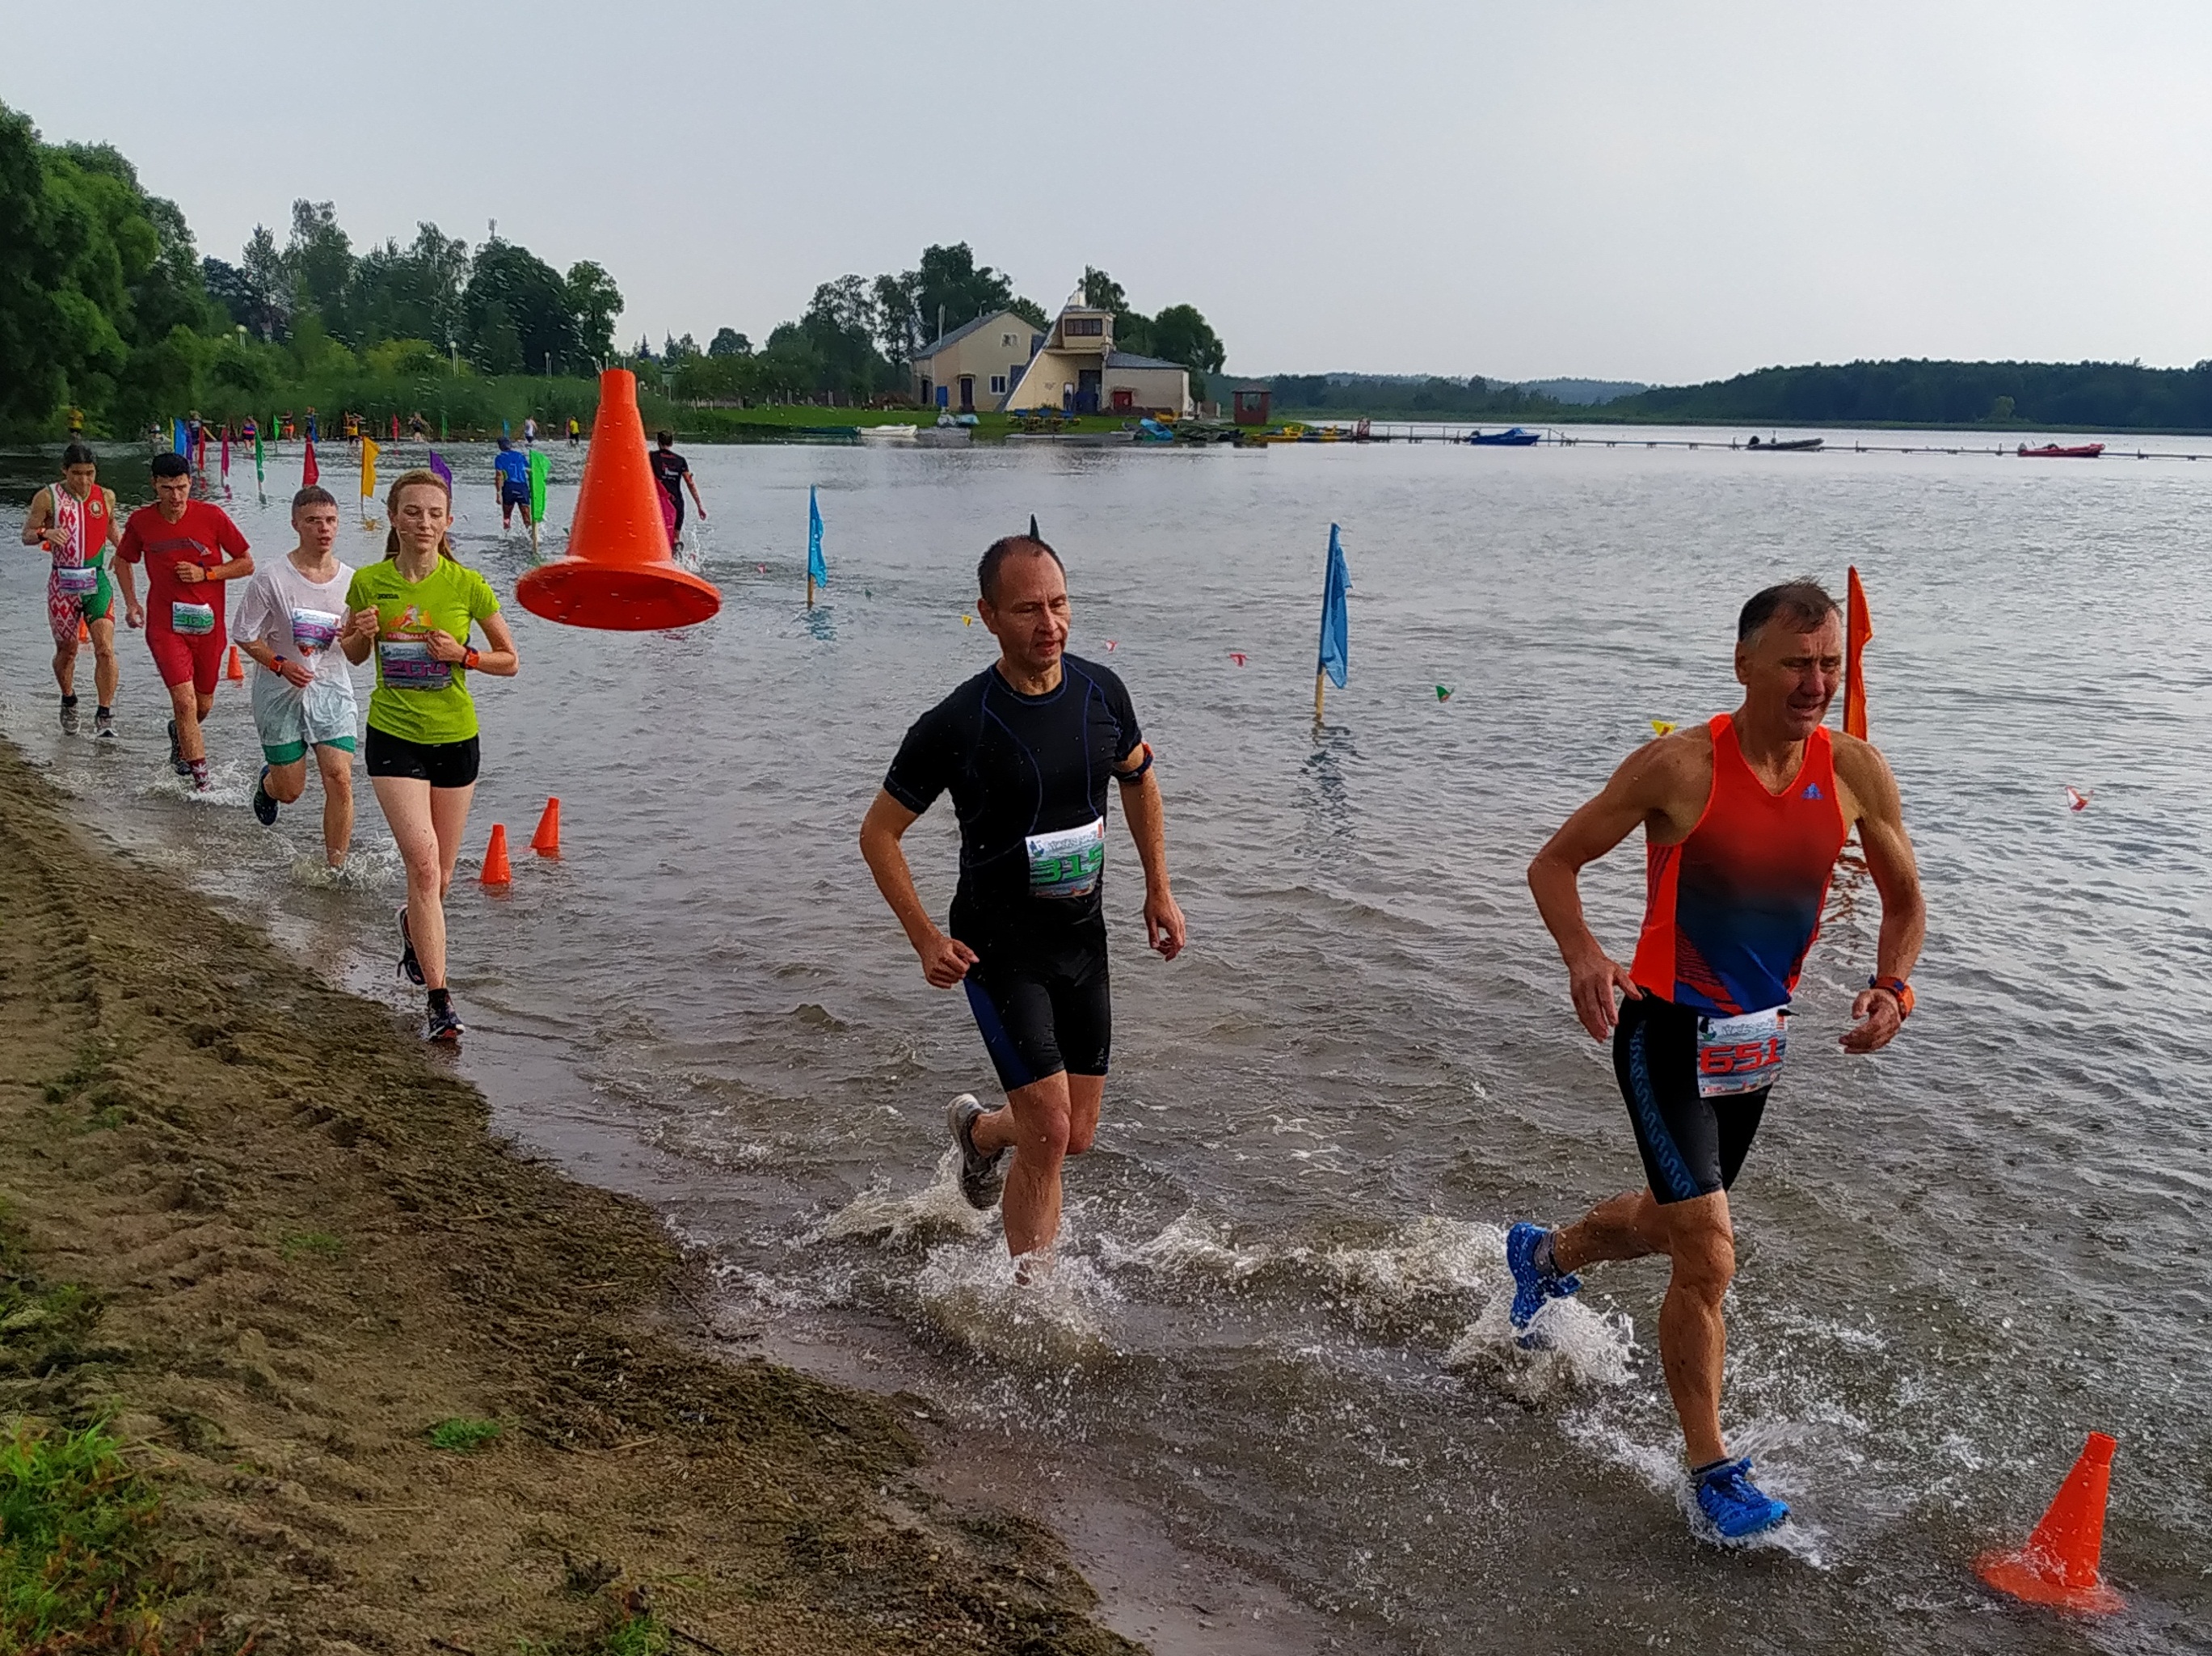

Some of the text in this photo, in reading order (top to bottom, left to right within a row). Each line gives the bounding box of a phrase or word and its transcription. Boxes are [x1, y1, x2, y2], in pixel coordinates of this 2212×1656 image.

[383, 659, 449, 677] 204
[1032, 842, 1104, 883] 315
[1700, 1037, 1780, 1073] 651
